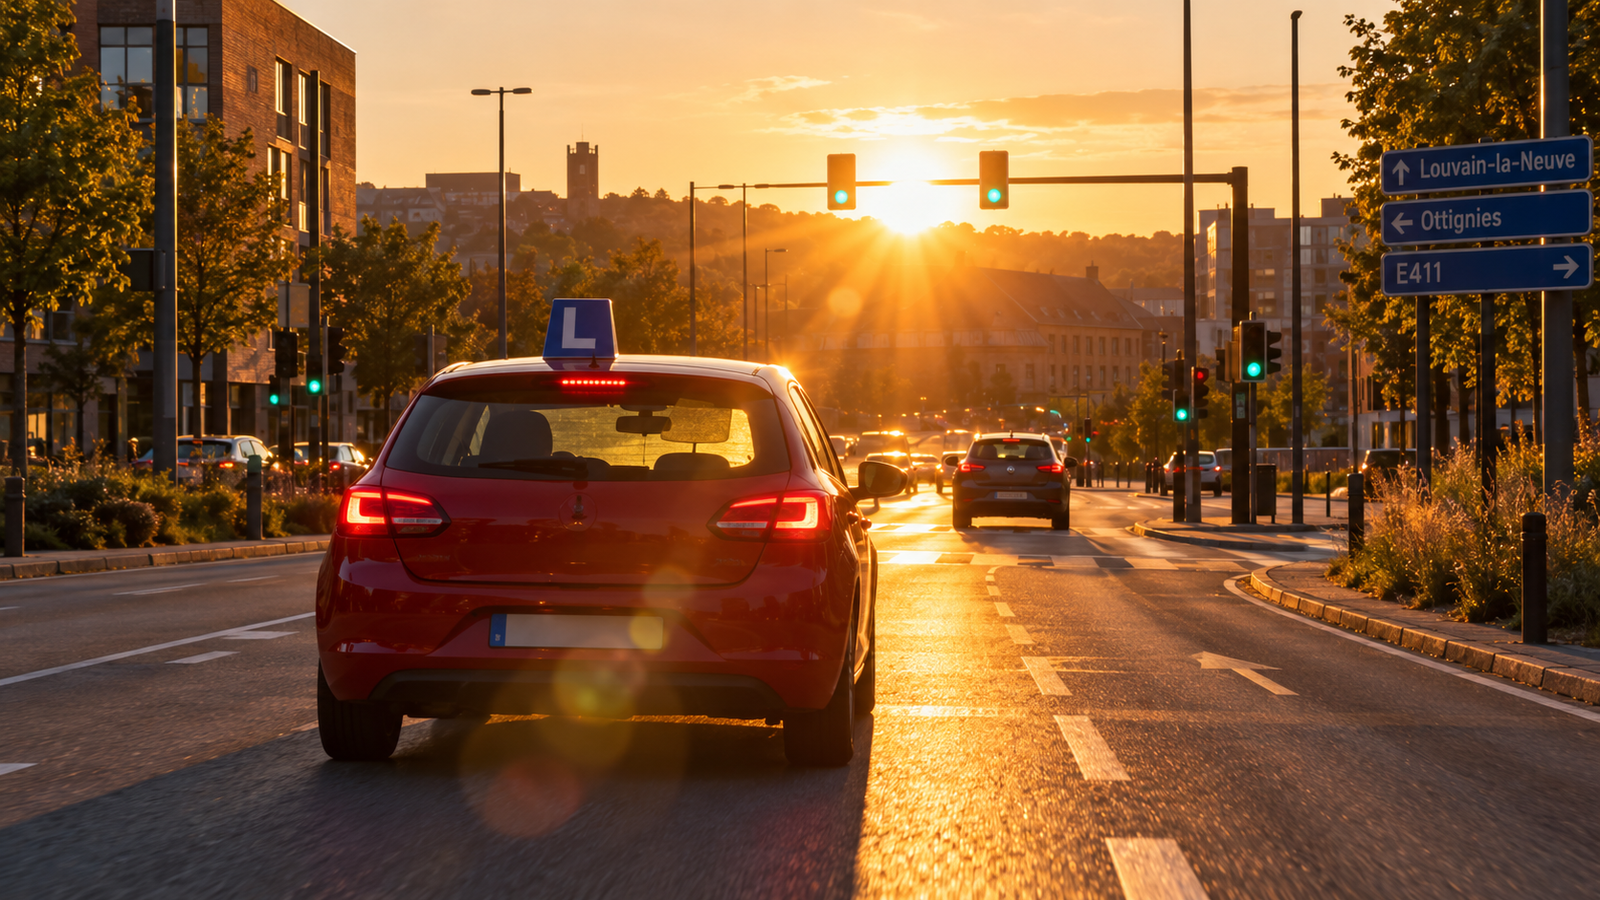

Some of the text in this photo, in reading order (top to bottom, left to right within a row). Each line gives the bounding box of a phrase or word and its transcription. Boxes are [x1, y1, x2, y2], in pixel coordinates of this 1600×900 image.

[1420, 151, 1575, 178] Louvain-la-Neuve
[1421, 207, 1502, 234] Ottignies
[1396, 261, 1441, 284] E411
[562, 307, 596, 349] L
